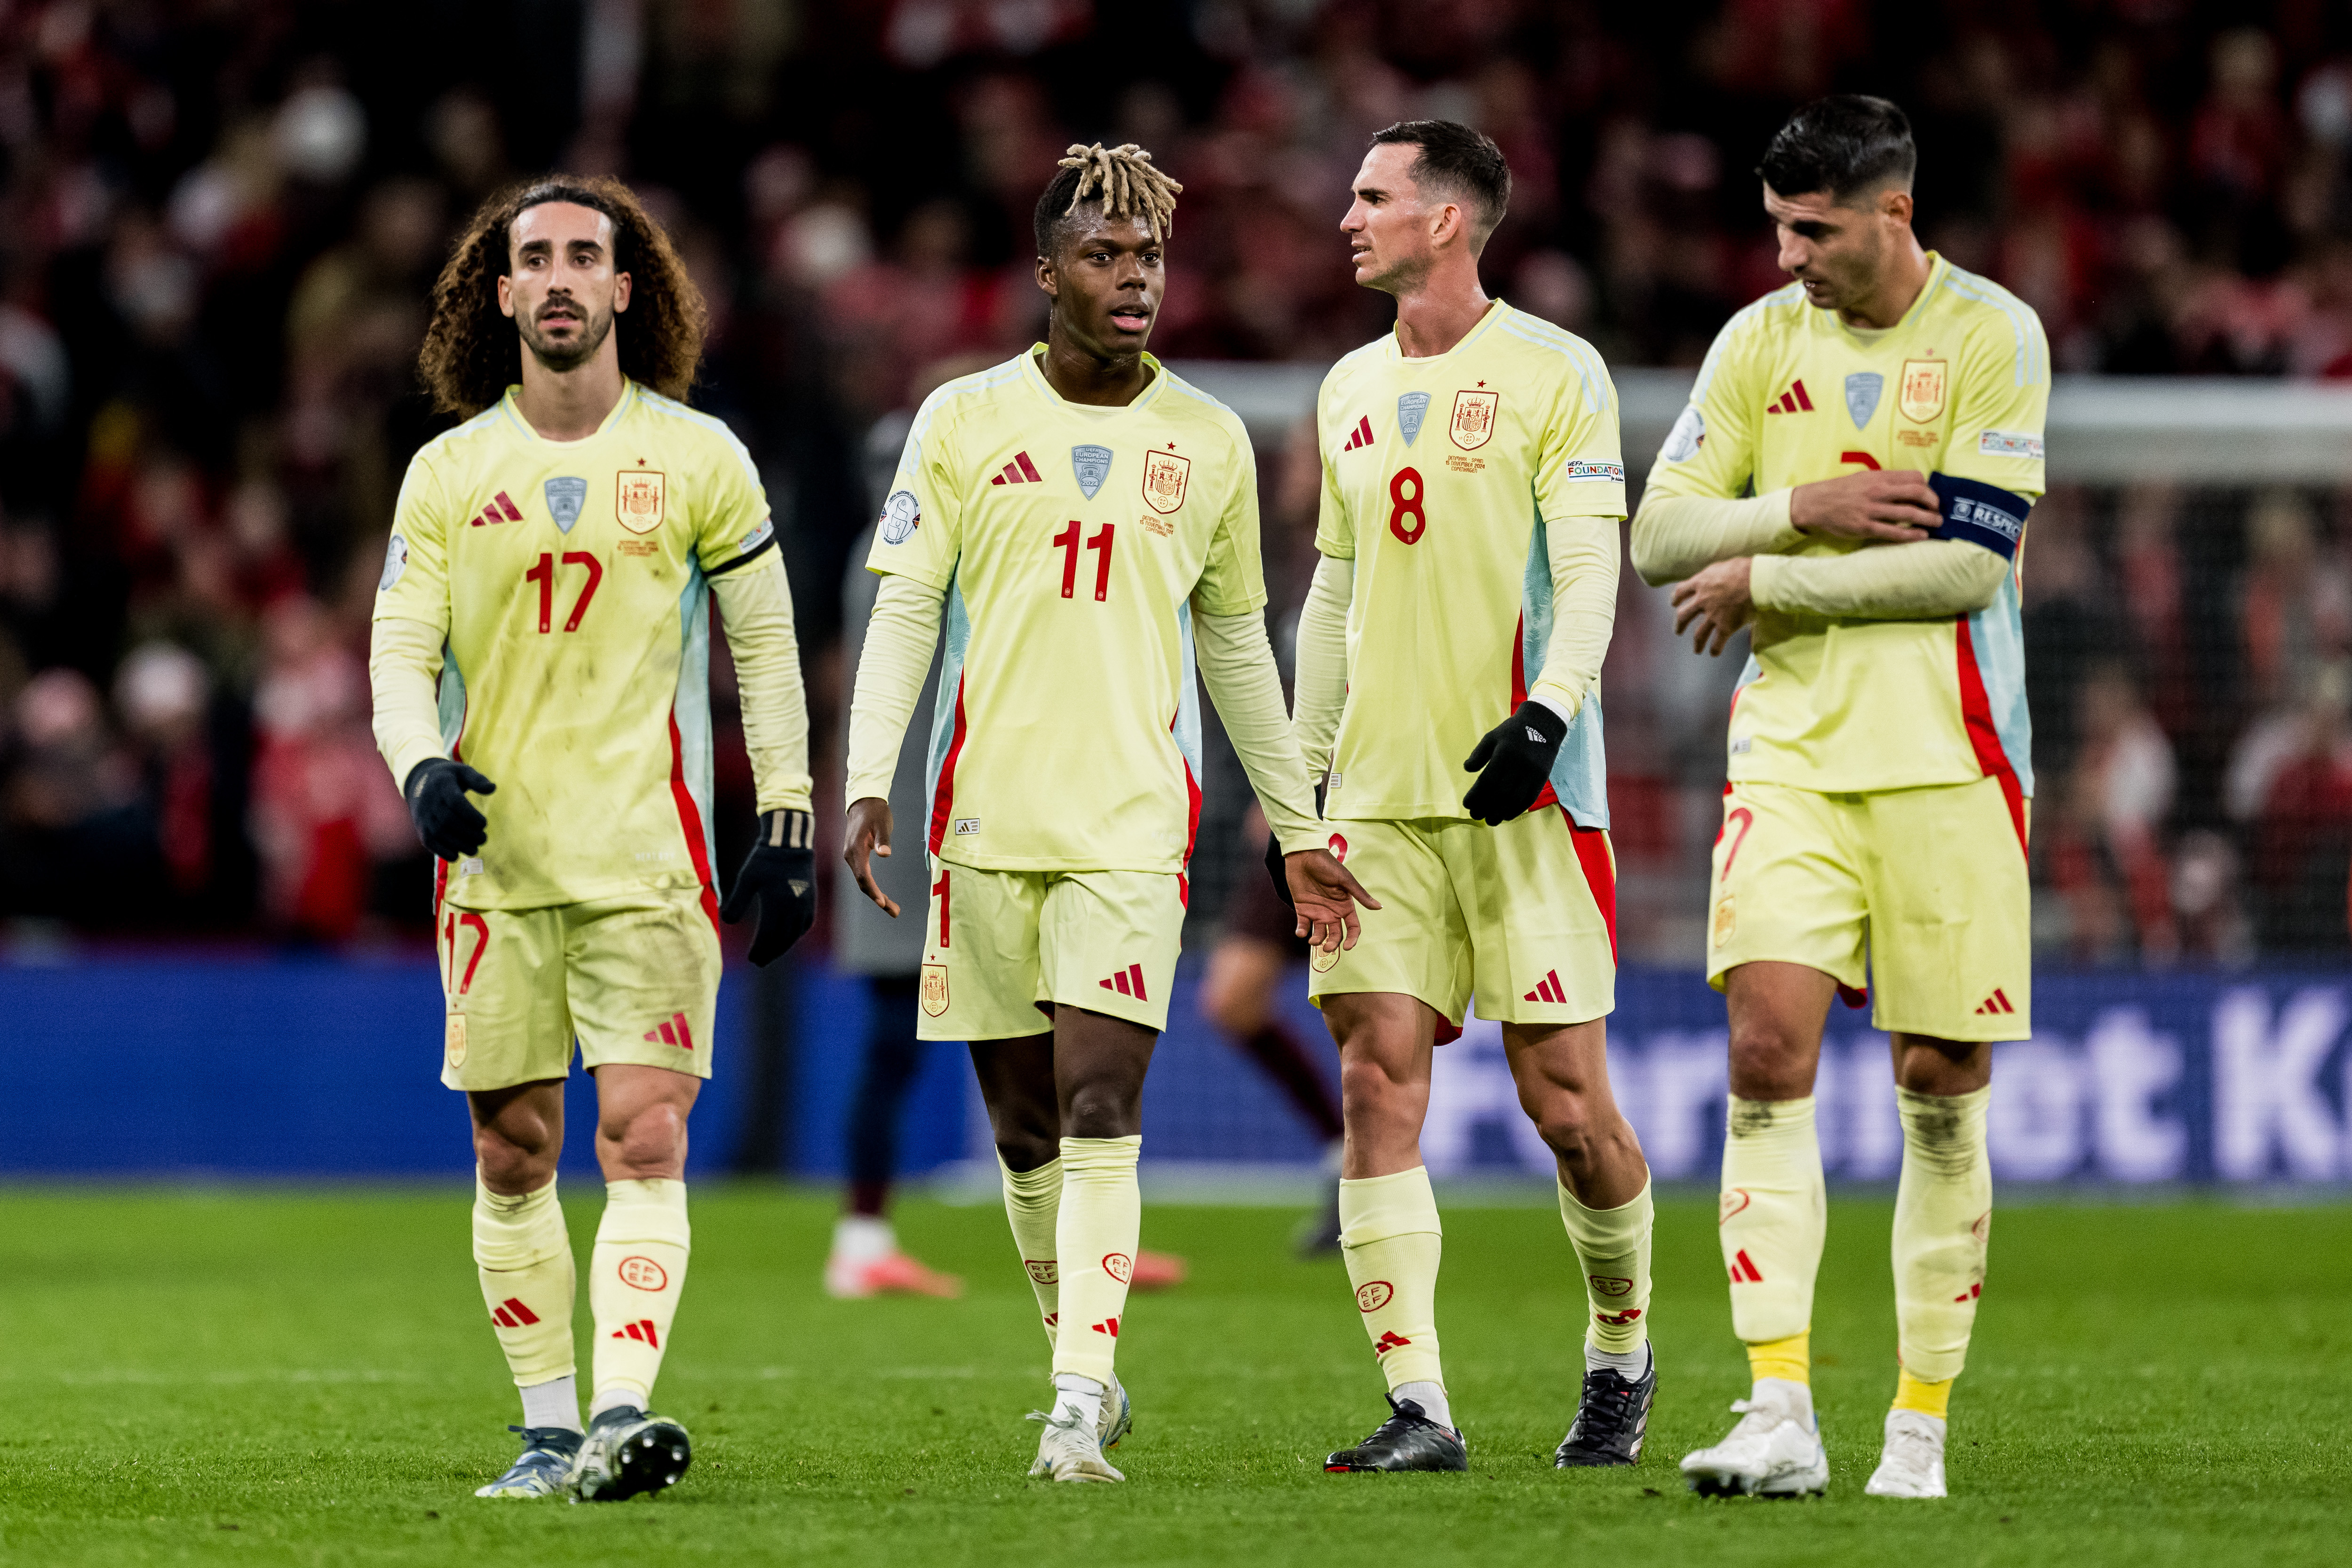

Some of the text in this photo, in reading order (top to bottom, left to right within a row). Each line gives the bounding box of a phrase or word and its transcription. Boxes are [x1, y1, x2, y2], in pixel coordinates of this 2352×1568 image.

[1568, 466, 1623, 476] FOUNDATION
[888, 494, 897, 502] UEFA
[909, 493, 919, 508] LEAGUE
[1390, 467, 1425, 545] 8
[883, 536, 895, 545] WINNER
[1054, 521, 1114, 602] 11
[527, 552, 602, 633] 17
[1525, 726, 1547, 743] adidas
[445, 912, 489, 994] 17
